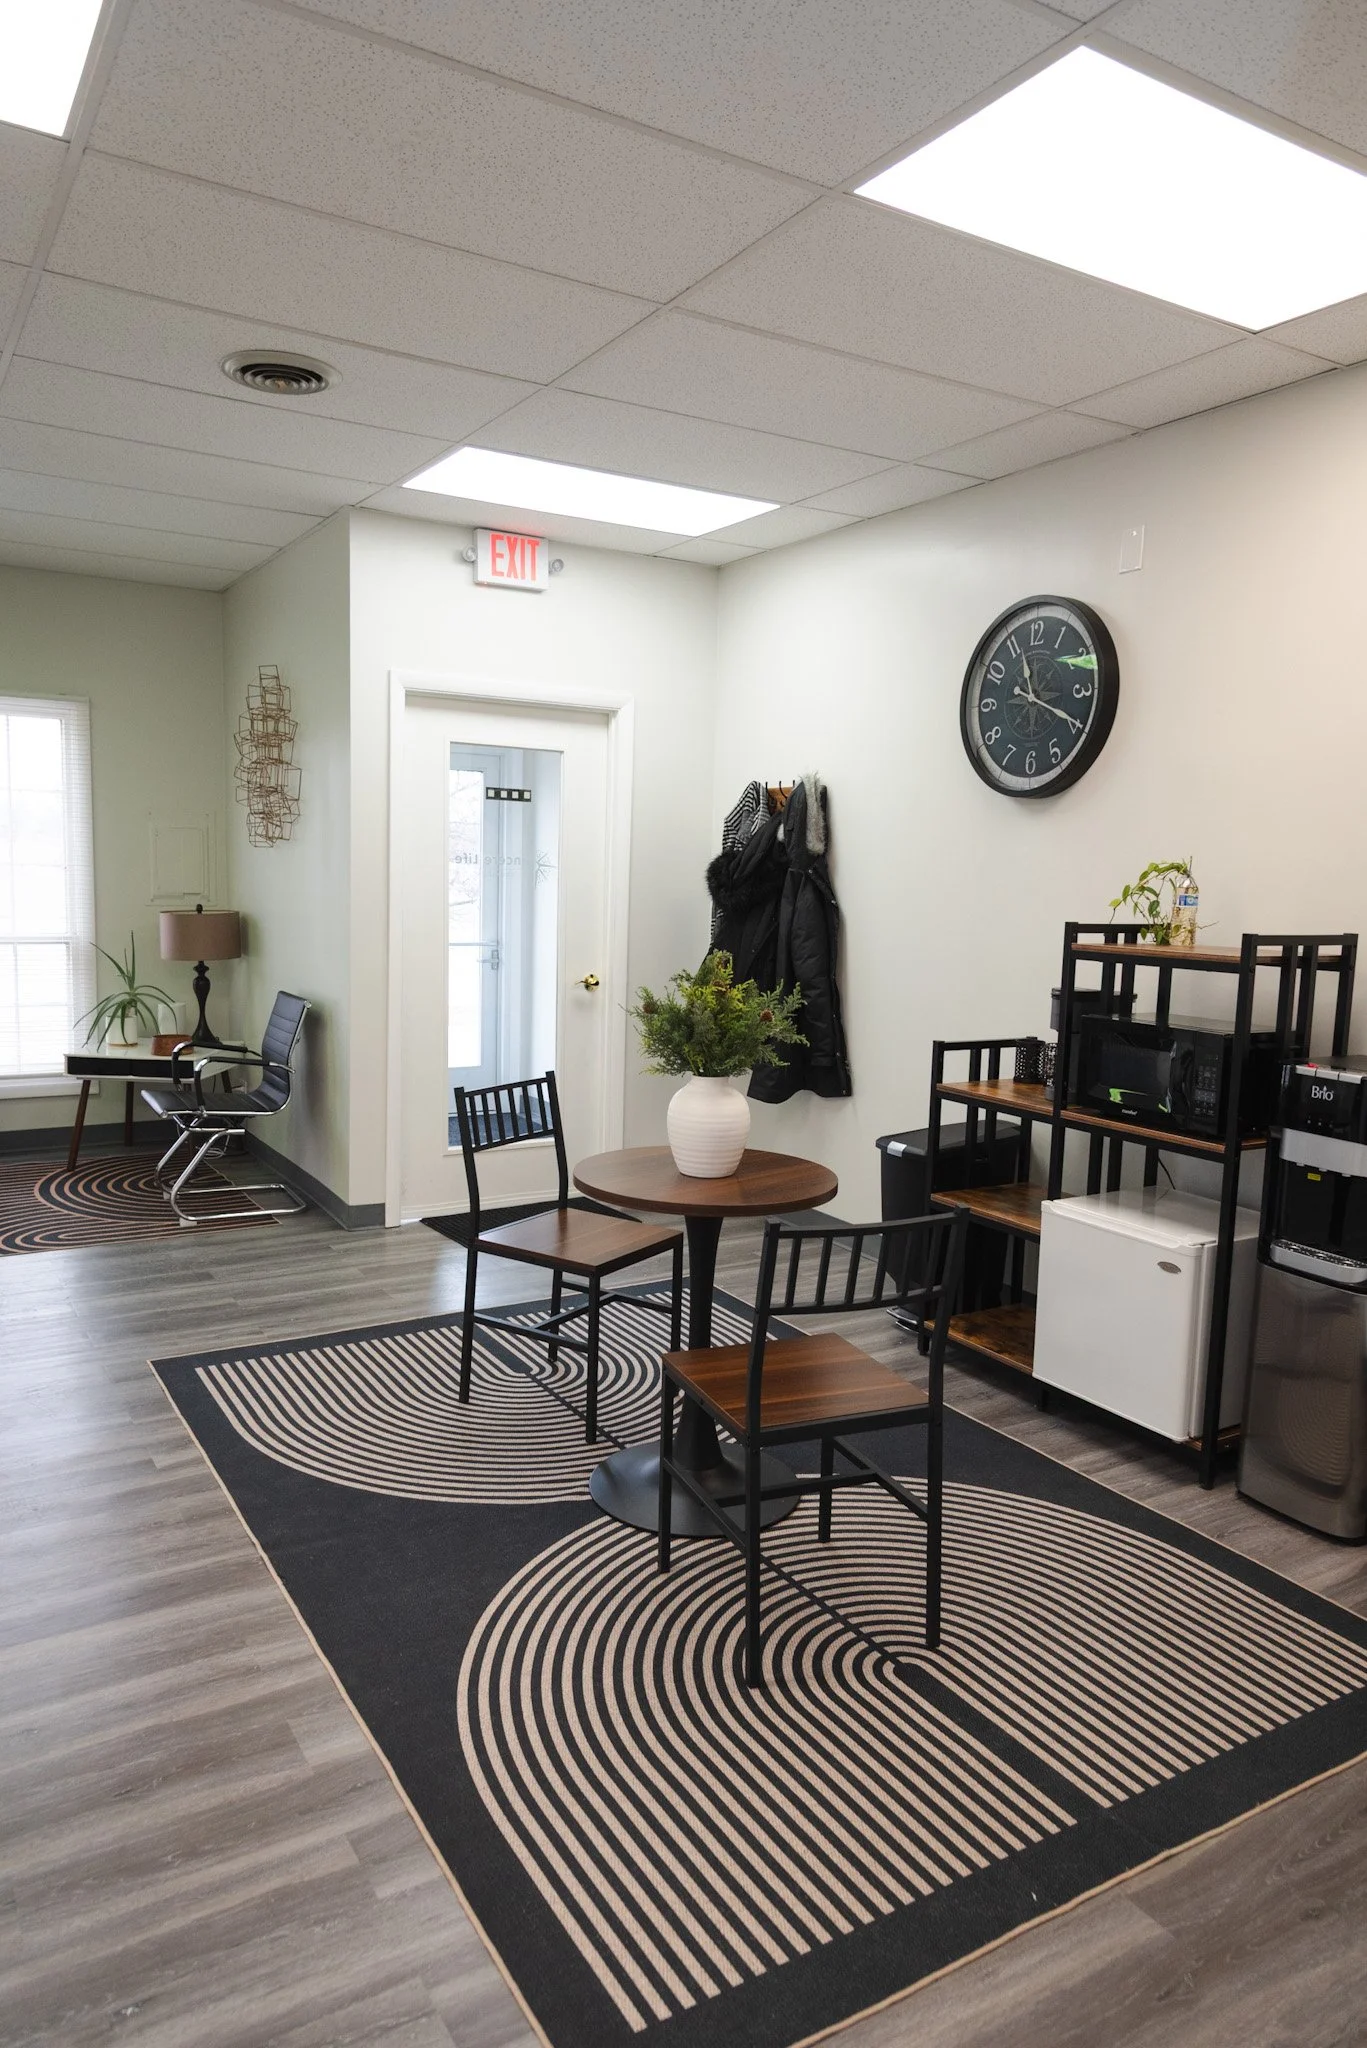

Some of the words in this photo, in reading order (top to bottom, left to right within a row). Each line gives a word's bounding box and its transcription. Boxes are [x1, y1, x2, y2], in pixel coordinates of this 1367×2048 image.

[490, 533, 540, 581] EXIT
[1029, 620, 1045, 646] 12
[1054, 626, 1066, 649] 1
[1006, 635, 1021, 659] 11
[1068, 647, 1087, 670] 2
[987, 660, 1006, 686] 10
[1072, 683, 1092, 699] 3
[981, 697, 997, 713] 9
[985, 726, 1002, 745] 8
[1067, 717, 1084, 734] 4
[1002, 743, 1017, 766] 7
[1025, 750, 1036, 775] 6
[1049, 738, 1061, 764] 5
[1311, 1085, 1334, 1102] Brio
